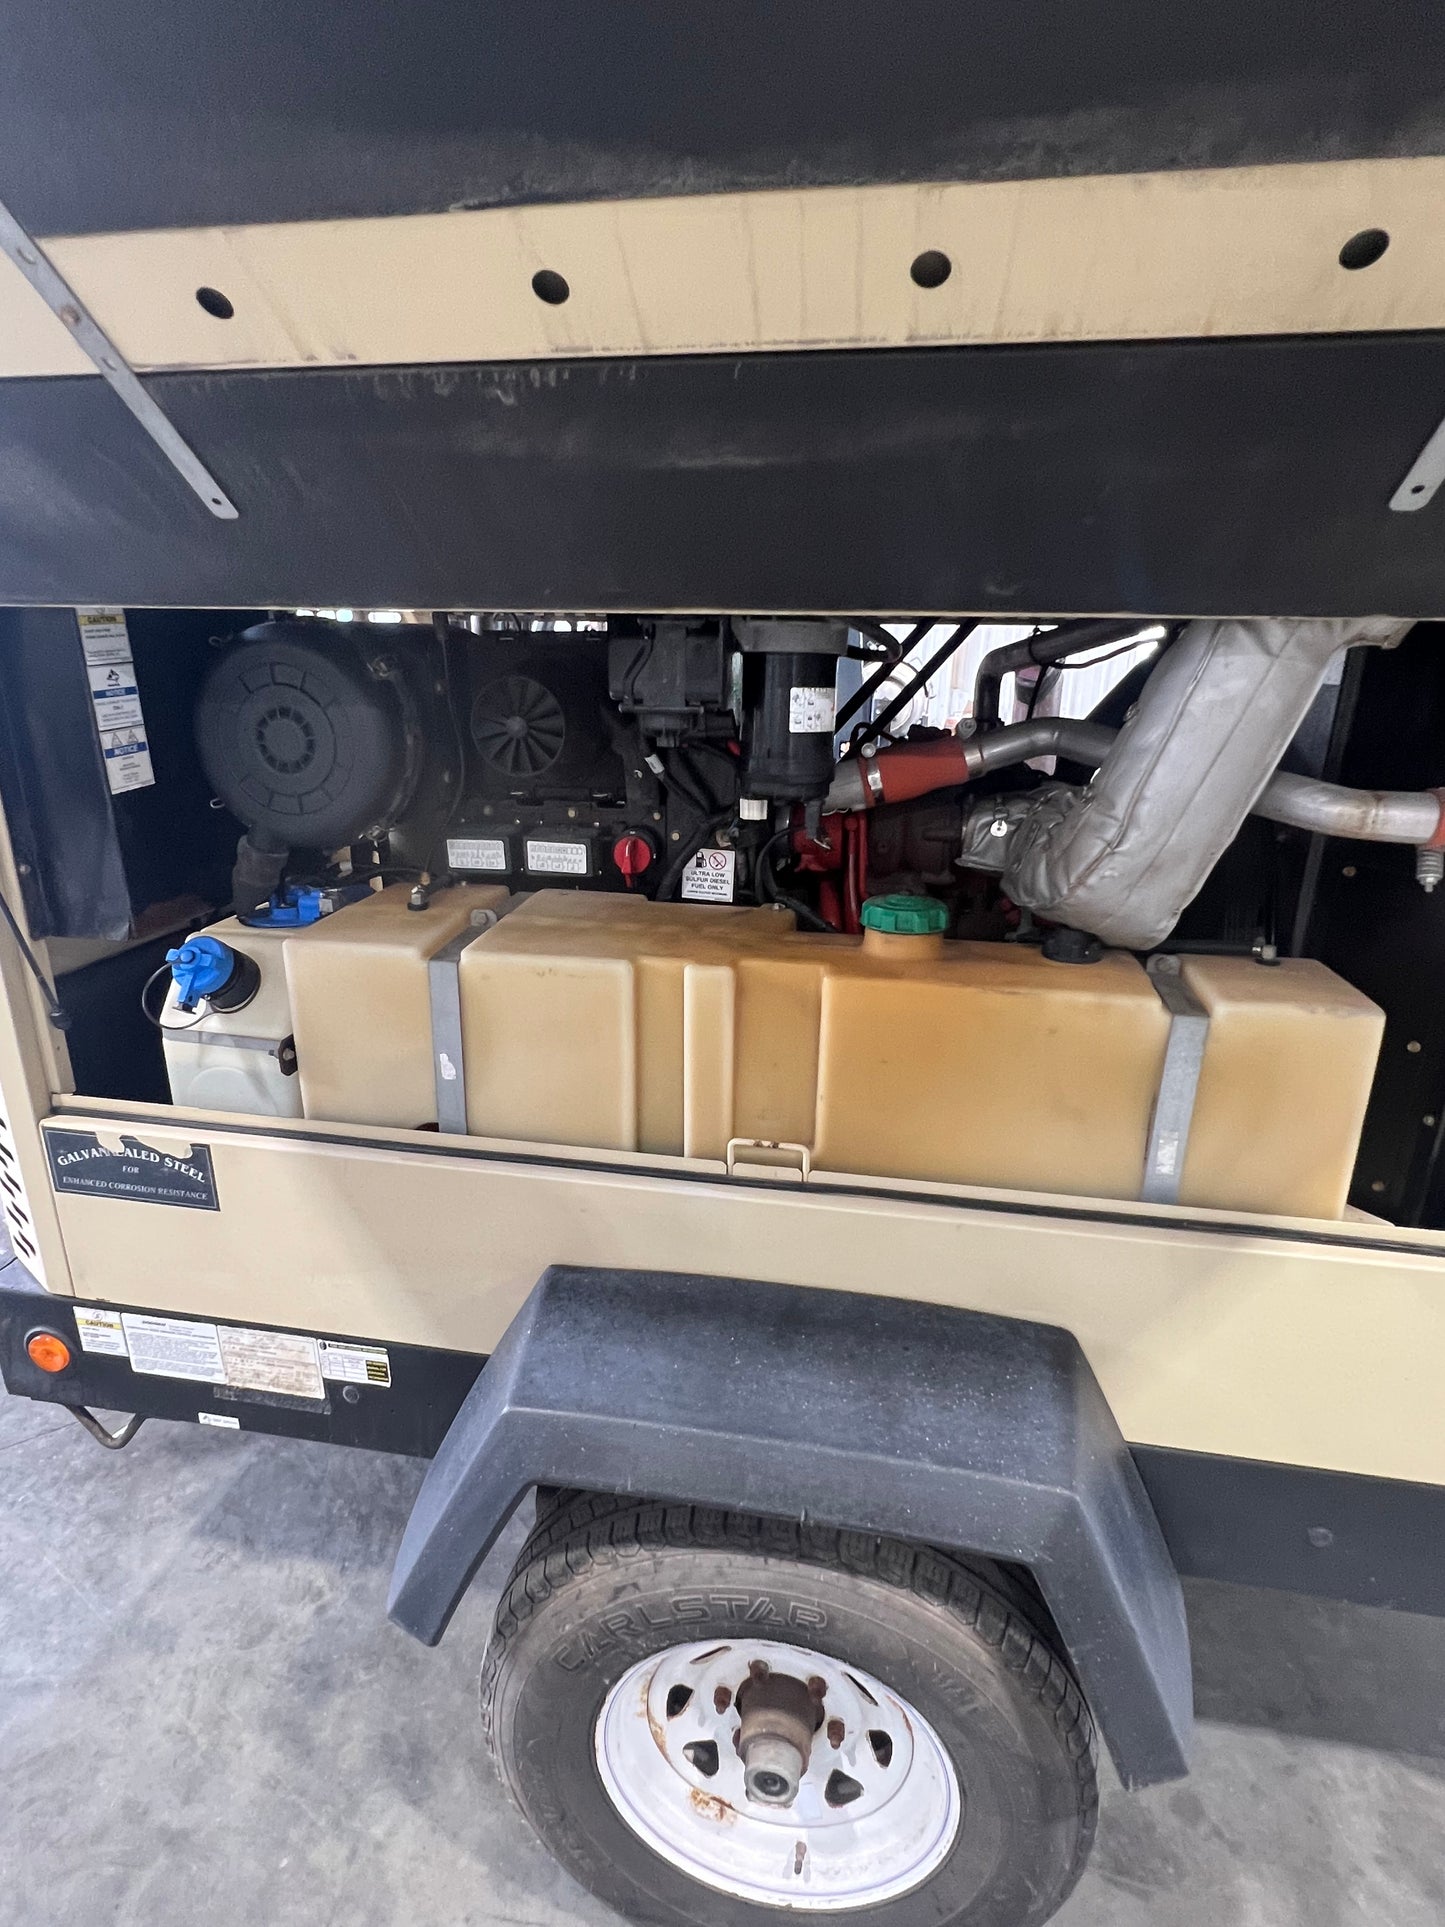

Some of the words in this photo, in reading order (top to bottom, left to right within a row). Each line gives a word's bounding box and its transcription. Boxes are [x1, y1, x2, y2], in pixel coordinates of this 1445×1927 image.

[709, 877, 730, 885] DIESEL
[122, 1165, 140, 1174] FOR
[163, 1156, 206, 1184] STEEL
[63, 1176, 108, 1188] ENHANCED
[108, 1182, 156, 1194] CORROSION
[157, 1188, 209, 1201] RESISTANCE
[551, 1594, 829, 1672] CARLSTAR
